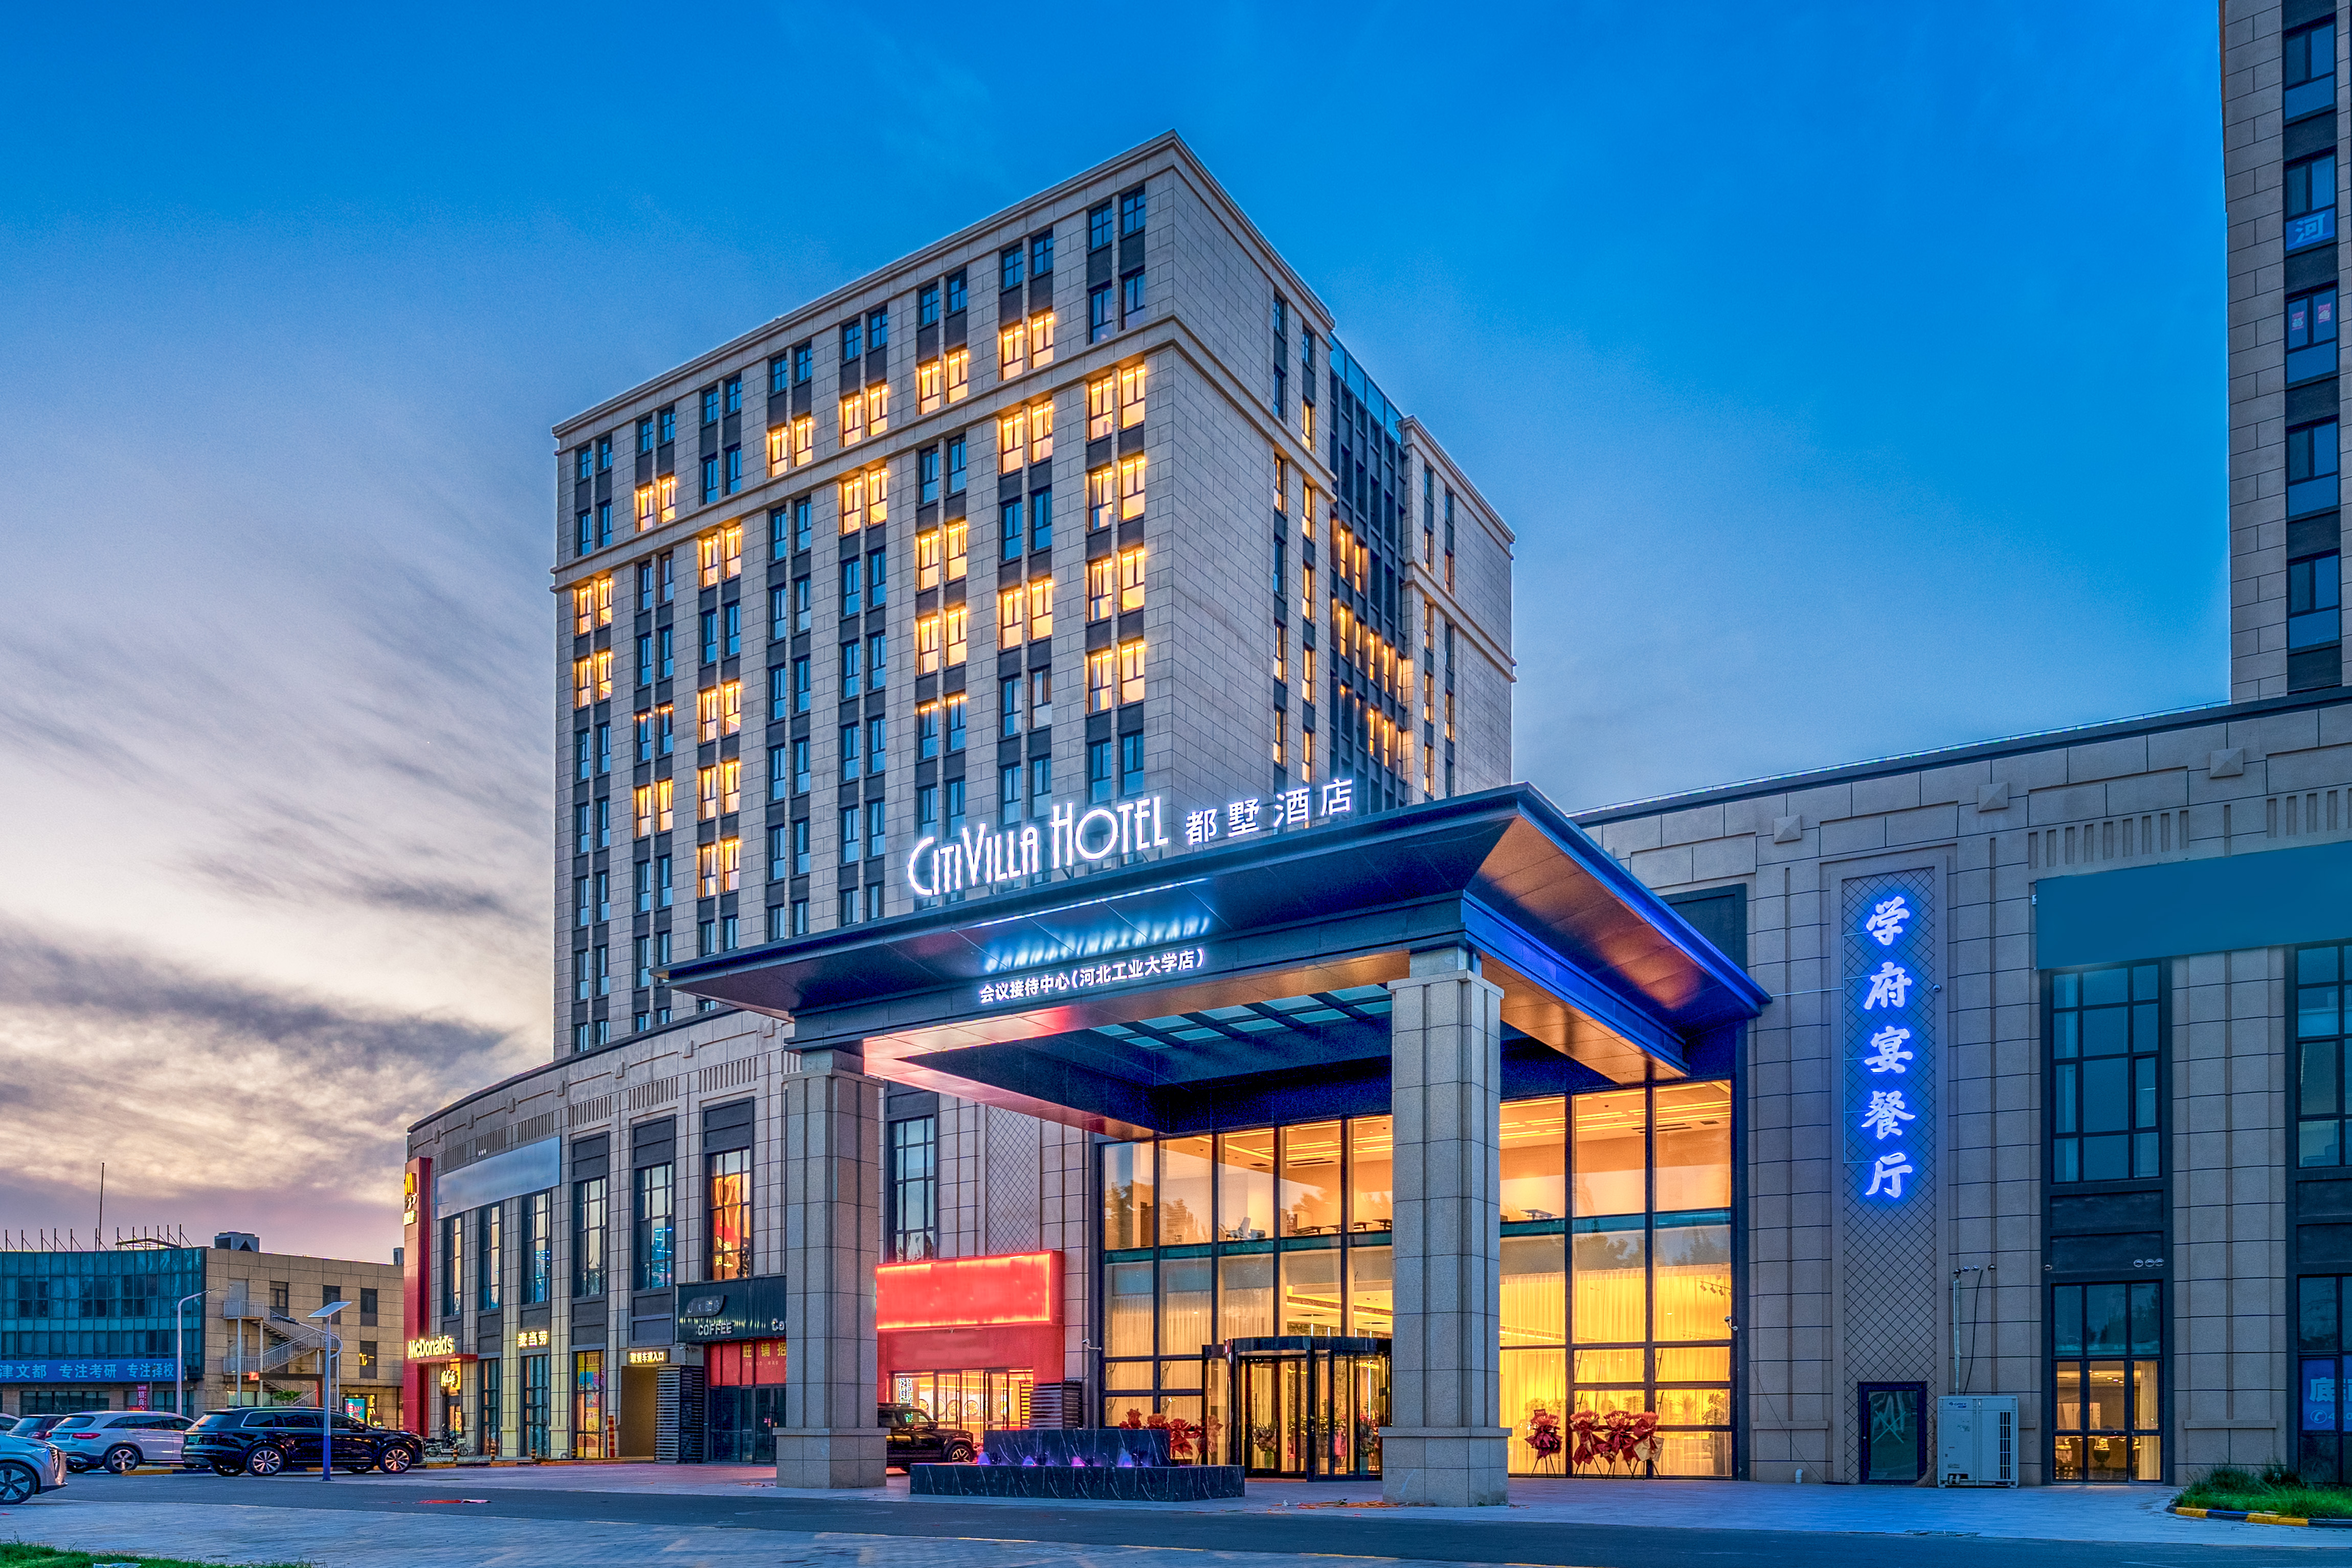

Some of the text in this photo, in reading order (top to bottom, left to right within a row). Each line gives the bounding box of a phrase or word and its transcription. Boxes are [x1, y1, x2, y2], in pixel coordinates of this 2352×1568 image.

[2295, 213, 2325, 243] 河
[1185, 778, 1353, 846] 都墅酒店
[1050, 796, 1169, 869] HOTEL
[1861, 895, 1915, 1198] 学府宴餐厅
[698, 1322, 732, 1336] COFFEE
[771, 1318, 787, 1331] Co
[407, 1335, 455, 1359] McDonald's
[518, 1330, 548, 1347] 麦当劳
[0, 1363, 174, 1379] 津文都 专注考研 专注择校
